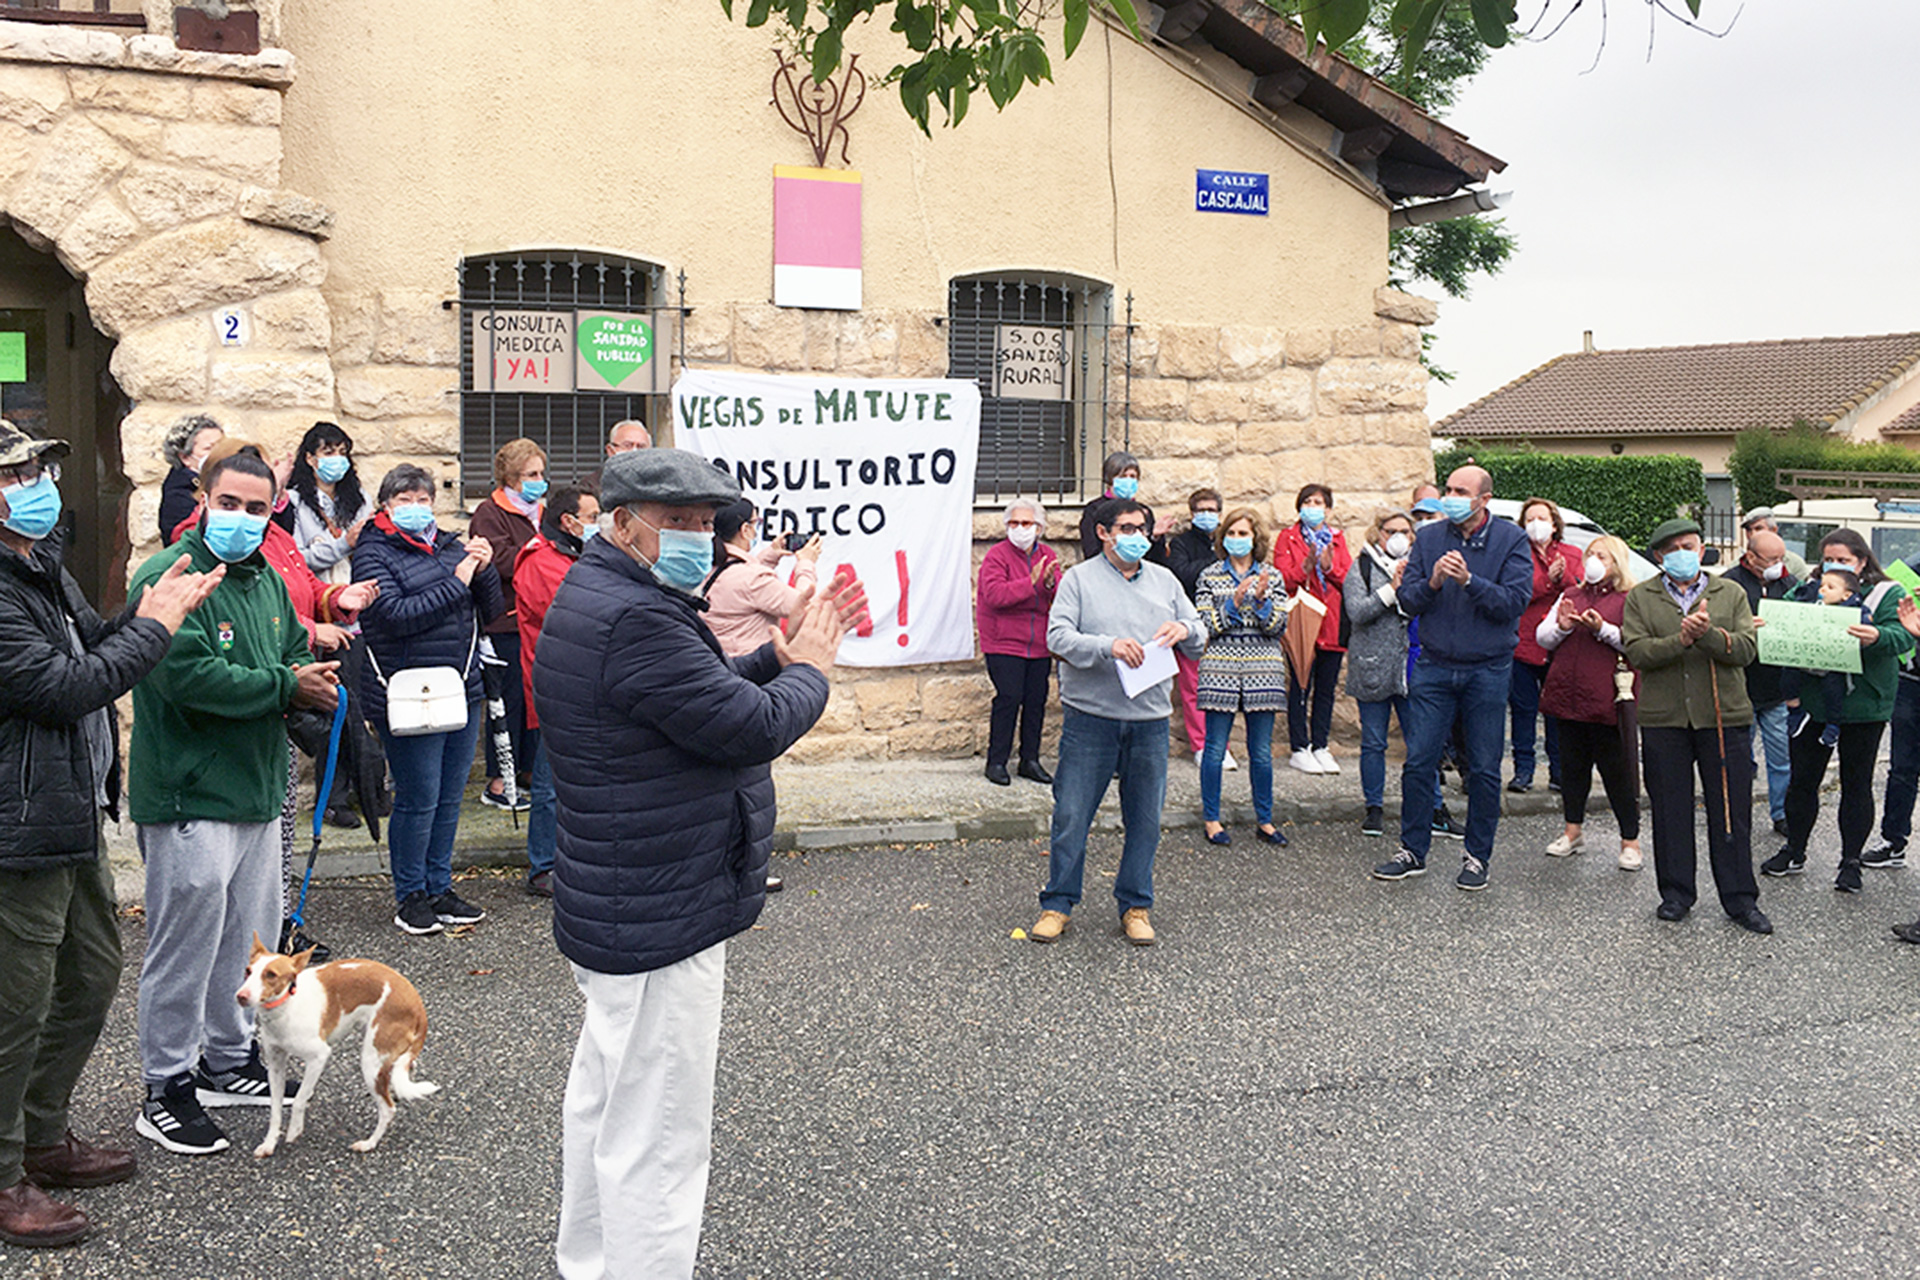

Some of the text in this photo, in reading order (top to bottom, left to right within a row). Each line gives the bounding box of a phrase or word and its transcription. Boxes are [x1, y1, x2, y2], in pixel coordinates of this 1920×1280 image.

[1212, 174, 1257, 187] CALLE
[1198, 190, 1267, 211] CASCAJAL
[225, 315, 239, 339] 2
[480, 315, 567, 334] CONSULTA
[602, 320, 643, 334] POR LA
[496, 336, 564, 353] MEDICA
[592, 331, 648, 348] SANIDAD
[596, 348, 643, 364] PUBLICA
[1002, 366, 1063, 385] RURAL
[680, 388, 952, 429] VEGAS DE MATUTE
[705, 448, 957, 491] NSULTORIO
[755, 494, 886, 542] ÉDICO
